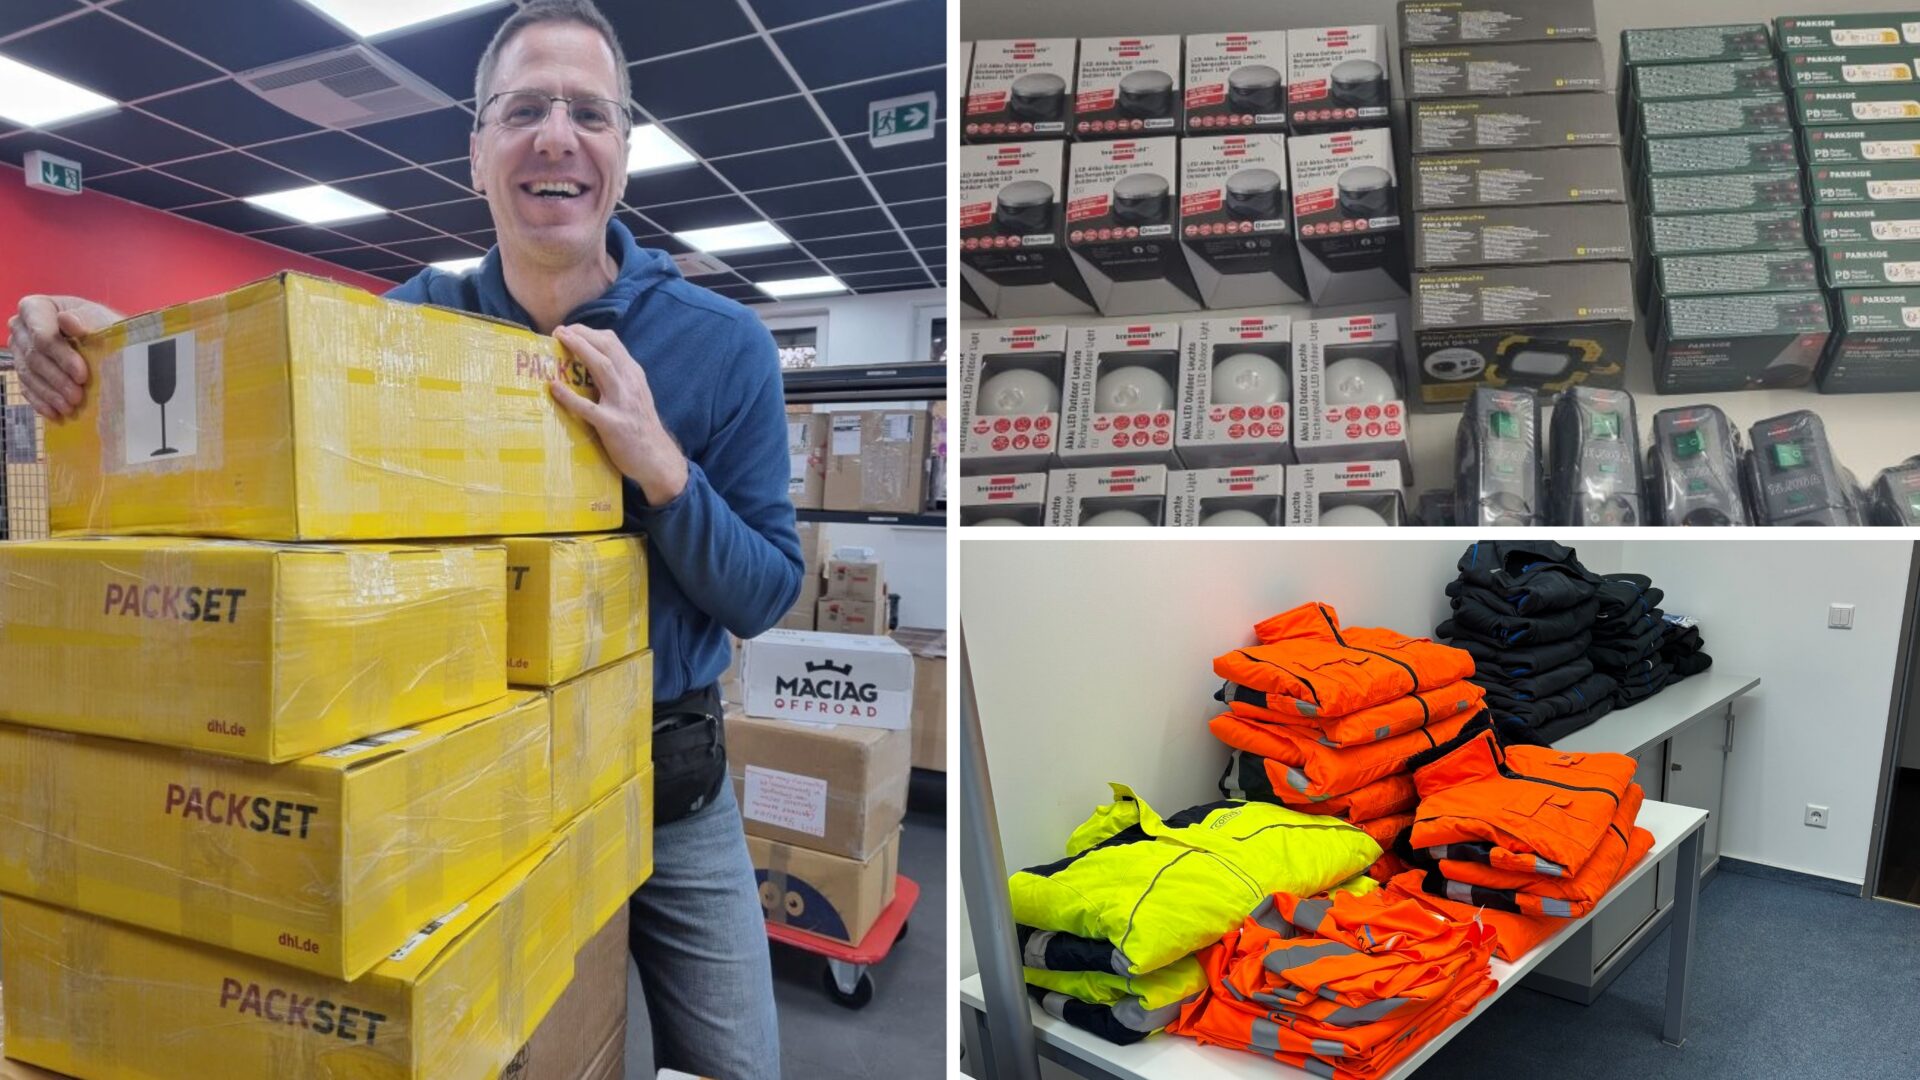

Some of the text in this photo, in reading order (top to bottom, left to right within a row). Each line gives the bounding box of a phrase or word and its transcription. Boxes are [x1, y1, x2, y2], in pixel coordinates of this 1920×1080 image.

[1830, 170, 1871, 178] PARKSIDE
[1832, 210, 1876, 218] PARKSIDE
[1846, 251, 1888, 259] PARKSIDE
[1862, 296, 1906, 304] PARKSIDE
[516, 350, 594, 386] PACKSE
[104, 583, 247, 624] PACKSET
[775, 676, 878, 703] MACIAG
[774, 698, 876, 718] OFFROAD
[207, 720, 246, 737] dhl.de
[165, 784, 318, 839] PACKSET
[278, 932, 319, 954] dhl.de
[220, 977, 387, 1046] PACKSET
